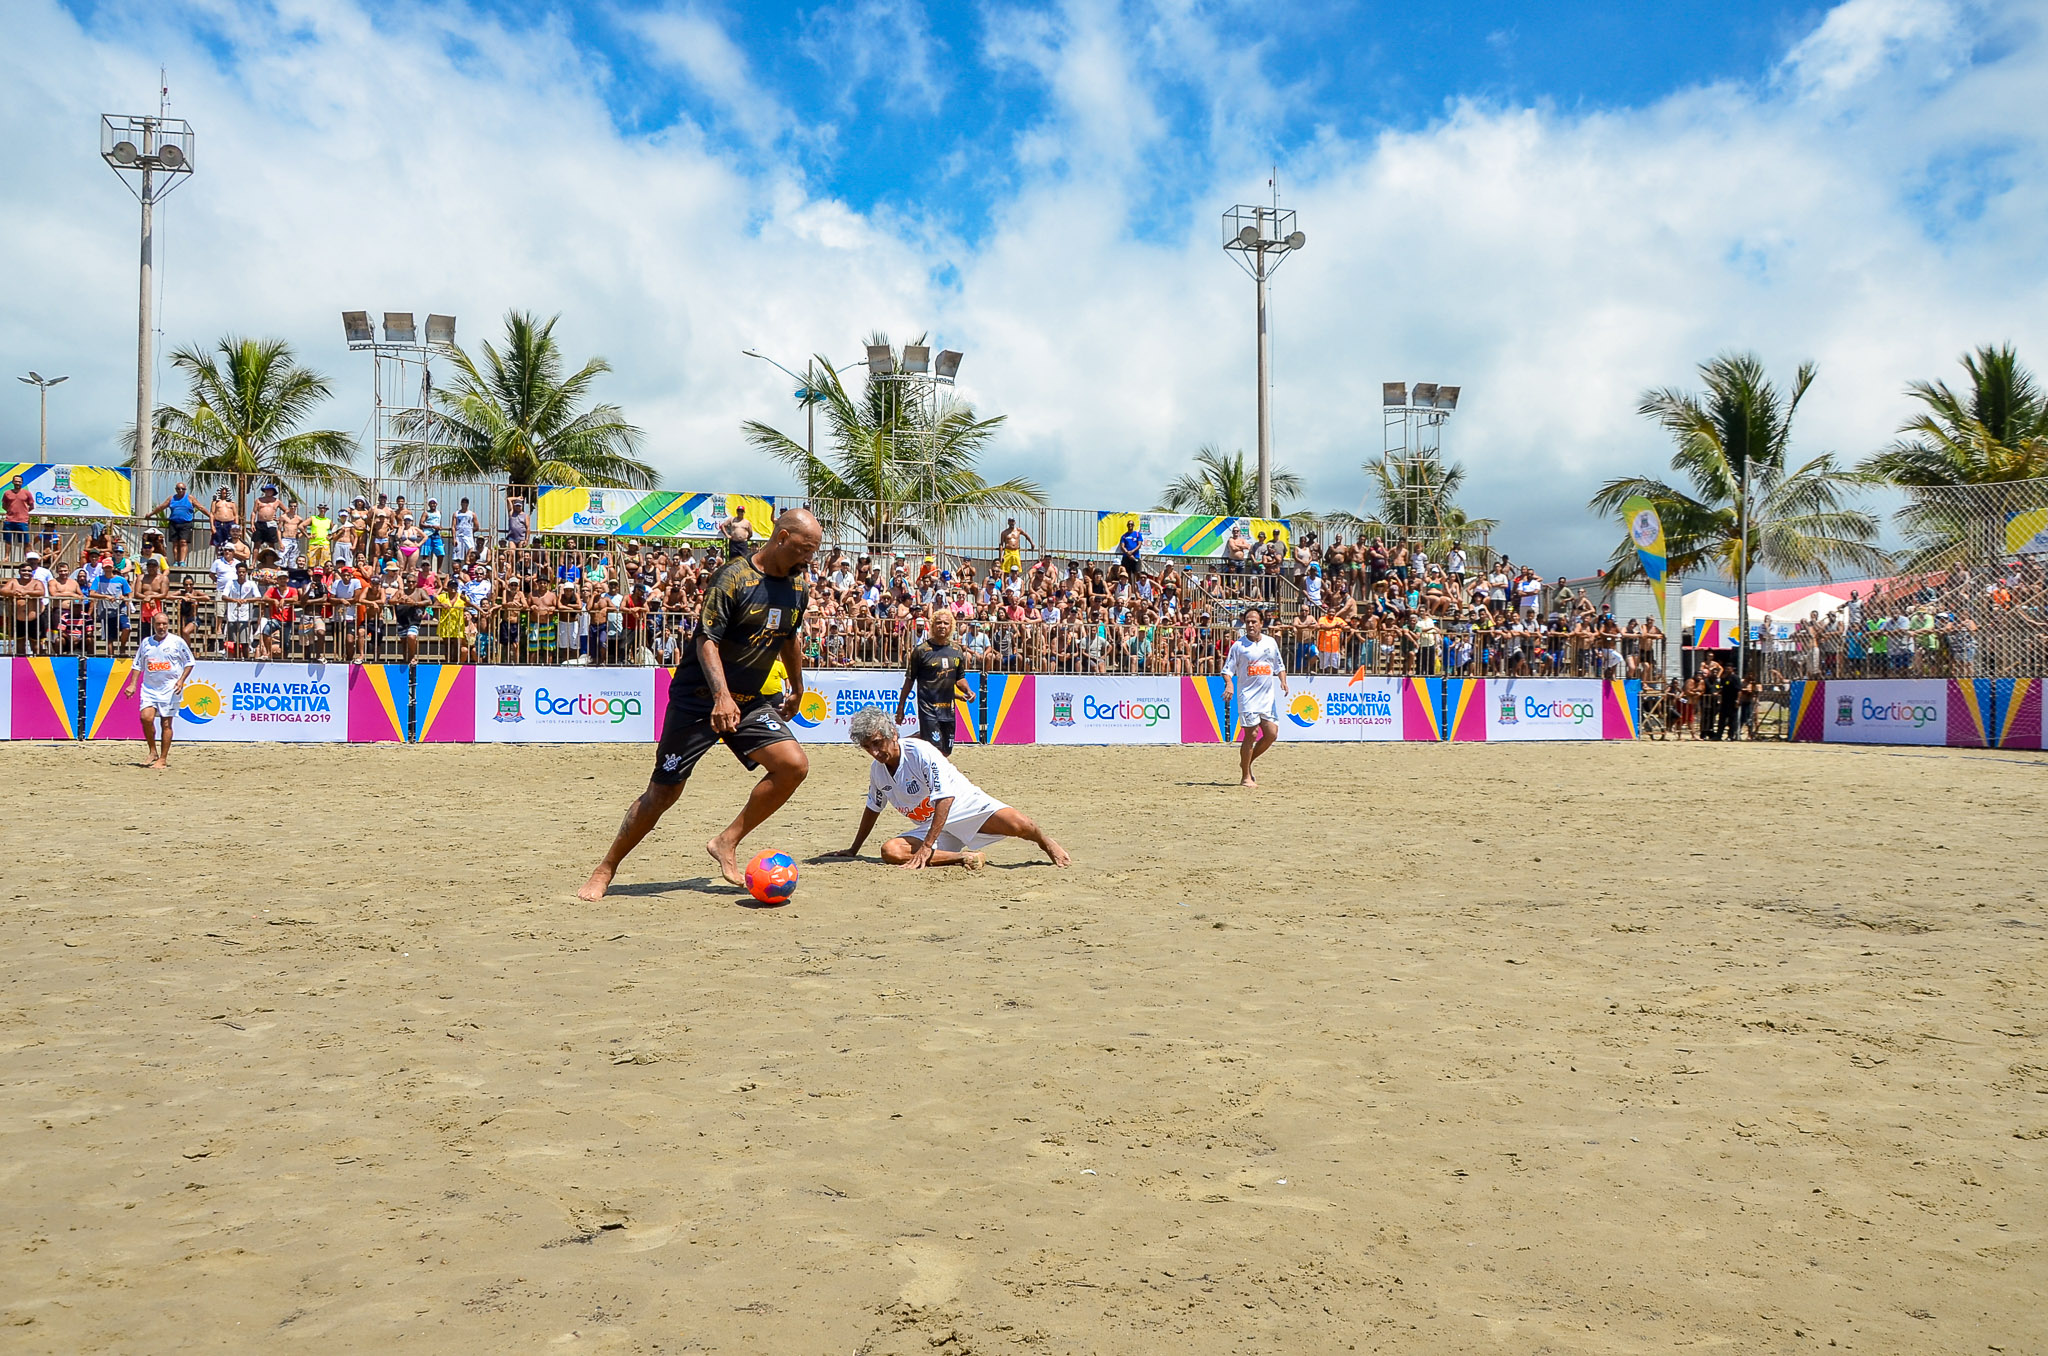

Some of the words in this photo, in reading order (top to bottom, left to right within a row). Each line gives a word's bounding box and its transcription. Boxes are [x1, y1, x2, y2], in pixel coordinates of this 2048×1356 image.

[35, 491, 89, 510] Bertioga
[573, 512, 619, 530] Bertioga
[697, 517, 723, 531] Berti
[233, 682, 281, 694] ARENA
[282, 680, 331, 695] VERÃO
[836, 689, 876, 700] ARENA
[232, 694, 331, 712] ESPORTIVA
[1326, 692, 1359, 703] ARENA
[1359, 690, 1391, 703] VERÃO
[535, 687, 642, 724] Bertioga
[1083, 694, 1170, 727] Bertioga
[1326, 703, 1392, 717] ESPORTIVA
[1524, 695, 1594, 725] Bertioga
[1861, 697, 1937, 728] Bertioga
[250, 713, 302, 723] BERTIOGA
[304, 713, 331, 723] 2019
[1339, 717, 1373, 725] BERTIOGA
[1374, 717, 1392, 725] 2019
